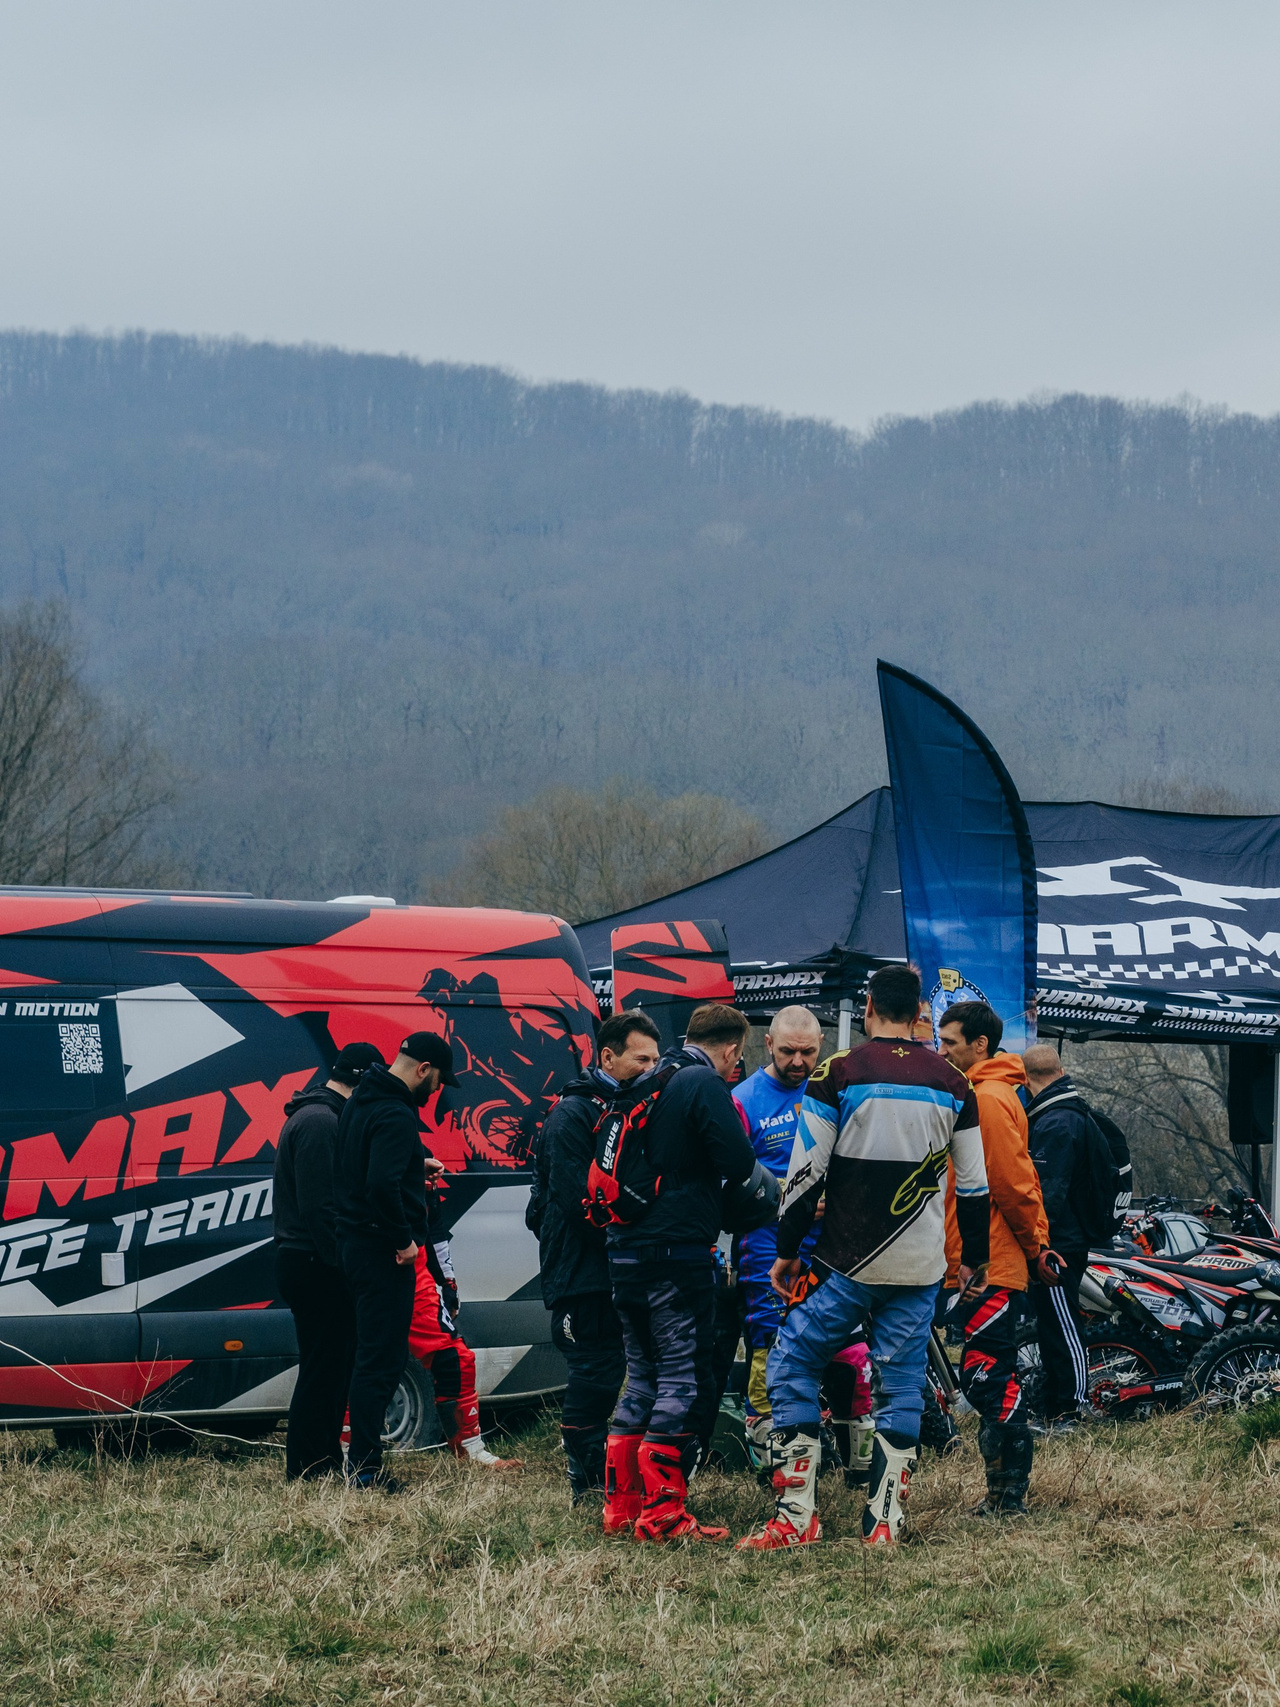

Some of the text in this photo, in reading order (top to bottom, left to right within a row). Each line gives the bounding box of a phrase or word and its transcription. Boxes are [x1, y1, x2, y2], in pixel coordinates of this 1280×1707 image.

[780, 988, 820, 999] RACE
[1037, 988, 1148, 1014] HARMAX
[14, 1002, 100, 1016] MOTION
[1093, 1011, 1140, 1025] RACE
[1234, 1026, 1280, 1036] RACE
[759, 1110, 794, 1130] Hard
[112, 1178, 273, 1253] TEAM
[1154, 1381, 1183, 1392] SHAR
